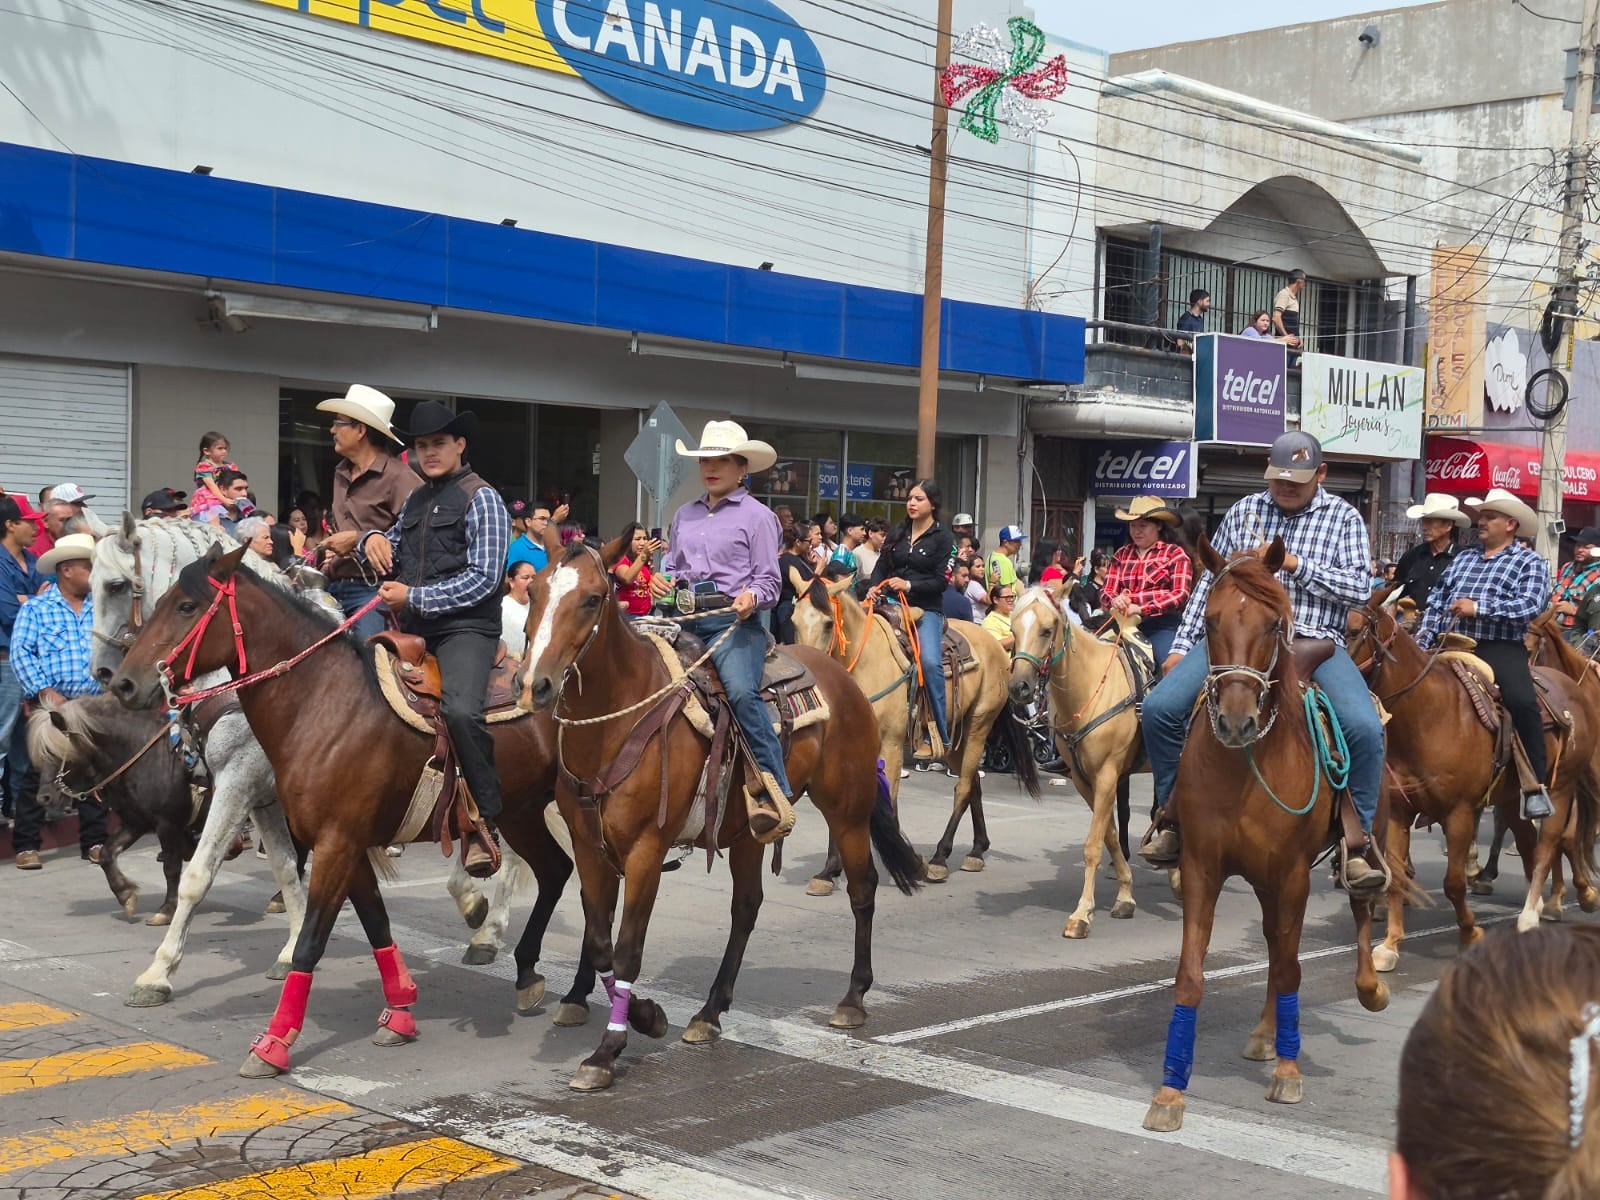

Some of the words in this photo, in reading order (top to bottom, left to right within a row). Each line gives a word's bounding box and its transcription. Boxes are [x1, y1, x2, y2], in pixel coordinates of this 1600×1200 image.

[552, 0, 804, 102] CANADA
[1222, 368, 1281, 405] telcel
[1328, 367, 1406, 412] MILLAN
[1428, 414, 1468, 429] DUMI
[850, 473, 872, 487] tenis
[1095, 449, 1187, 480] telcel
[1424, 451, 1484, 480] ca-Cola
